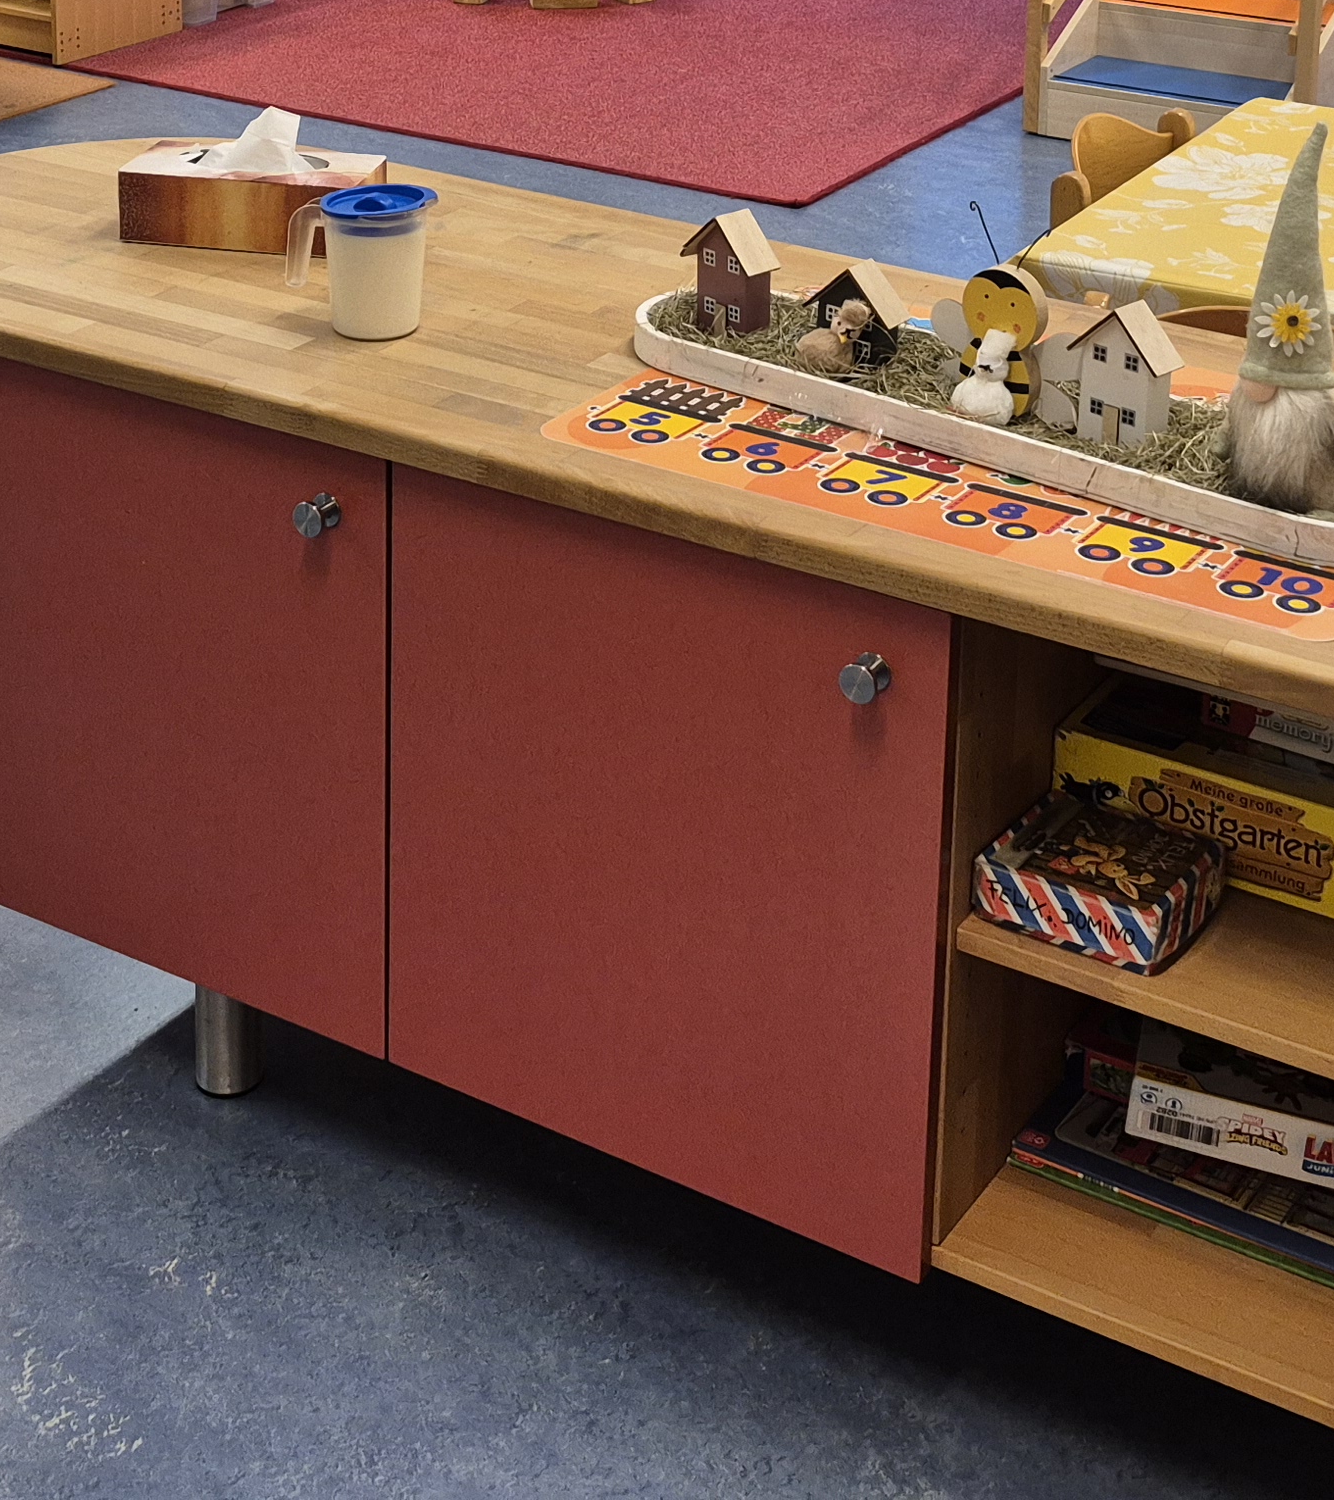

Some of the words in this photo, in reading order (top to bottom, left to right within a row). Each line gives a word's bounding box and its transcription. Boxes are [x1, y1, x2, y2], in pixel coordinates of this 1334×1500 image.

[629, 411, 671, 427] 5
[745, 442, 780, 457] 6
[864, 468, 910, 487] 7
[988, 502, 1029, 521] 8
[1128, 537, 1164, 555] 9
[1257, 567, 1324, 596] 10
[1255, 713, 1334, 753] memory
[1190, 778, 1235, 802] Meine
[1239, 794, 1284, 817] große
[1138, 786, 1323, 868] Obstgarten
